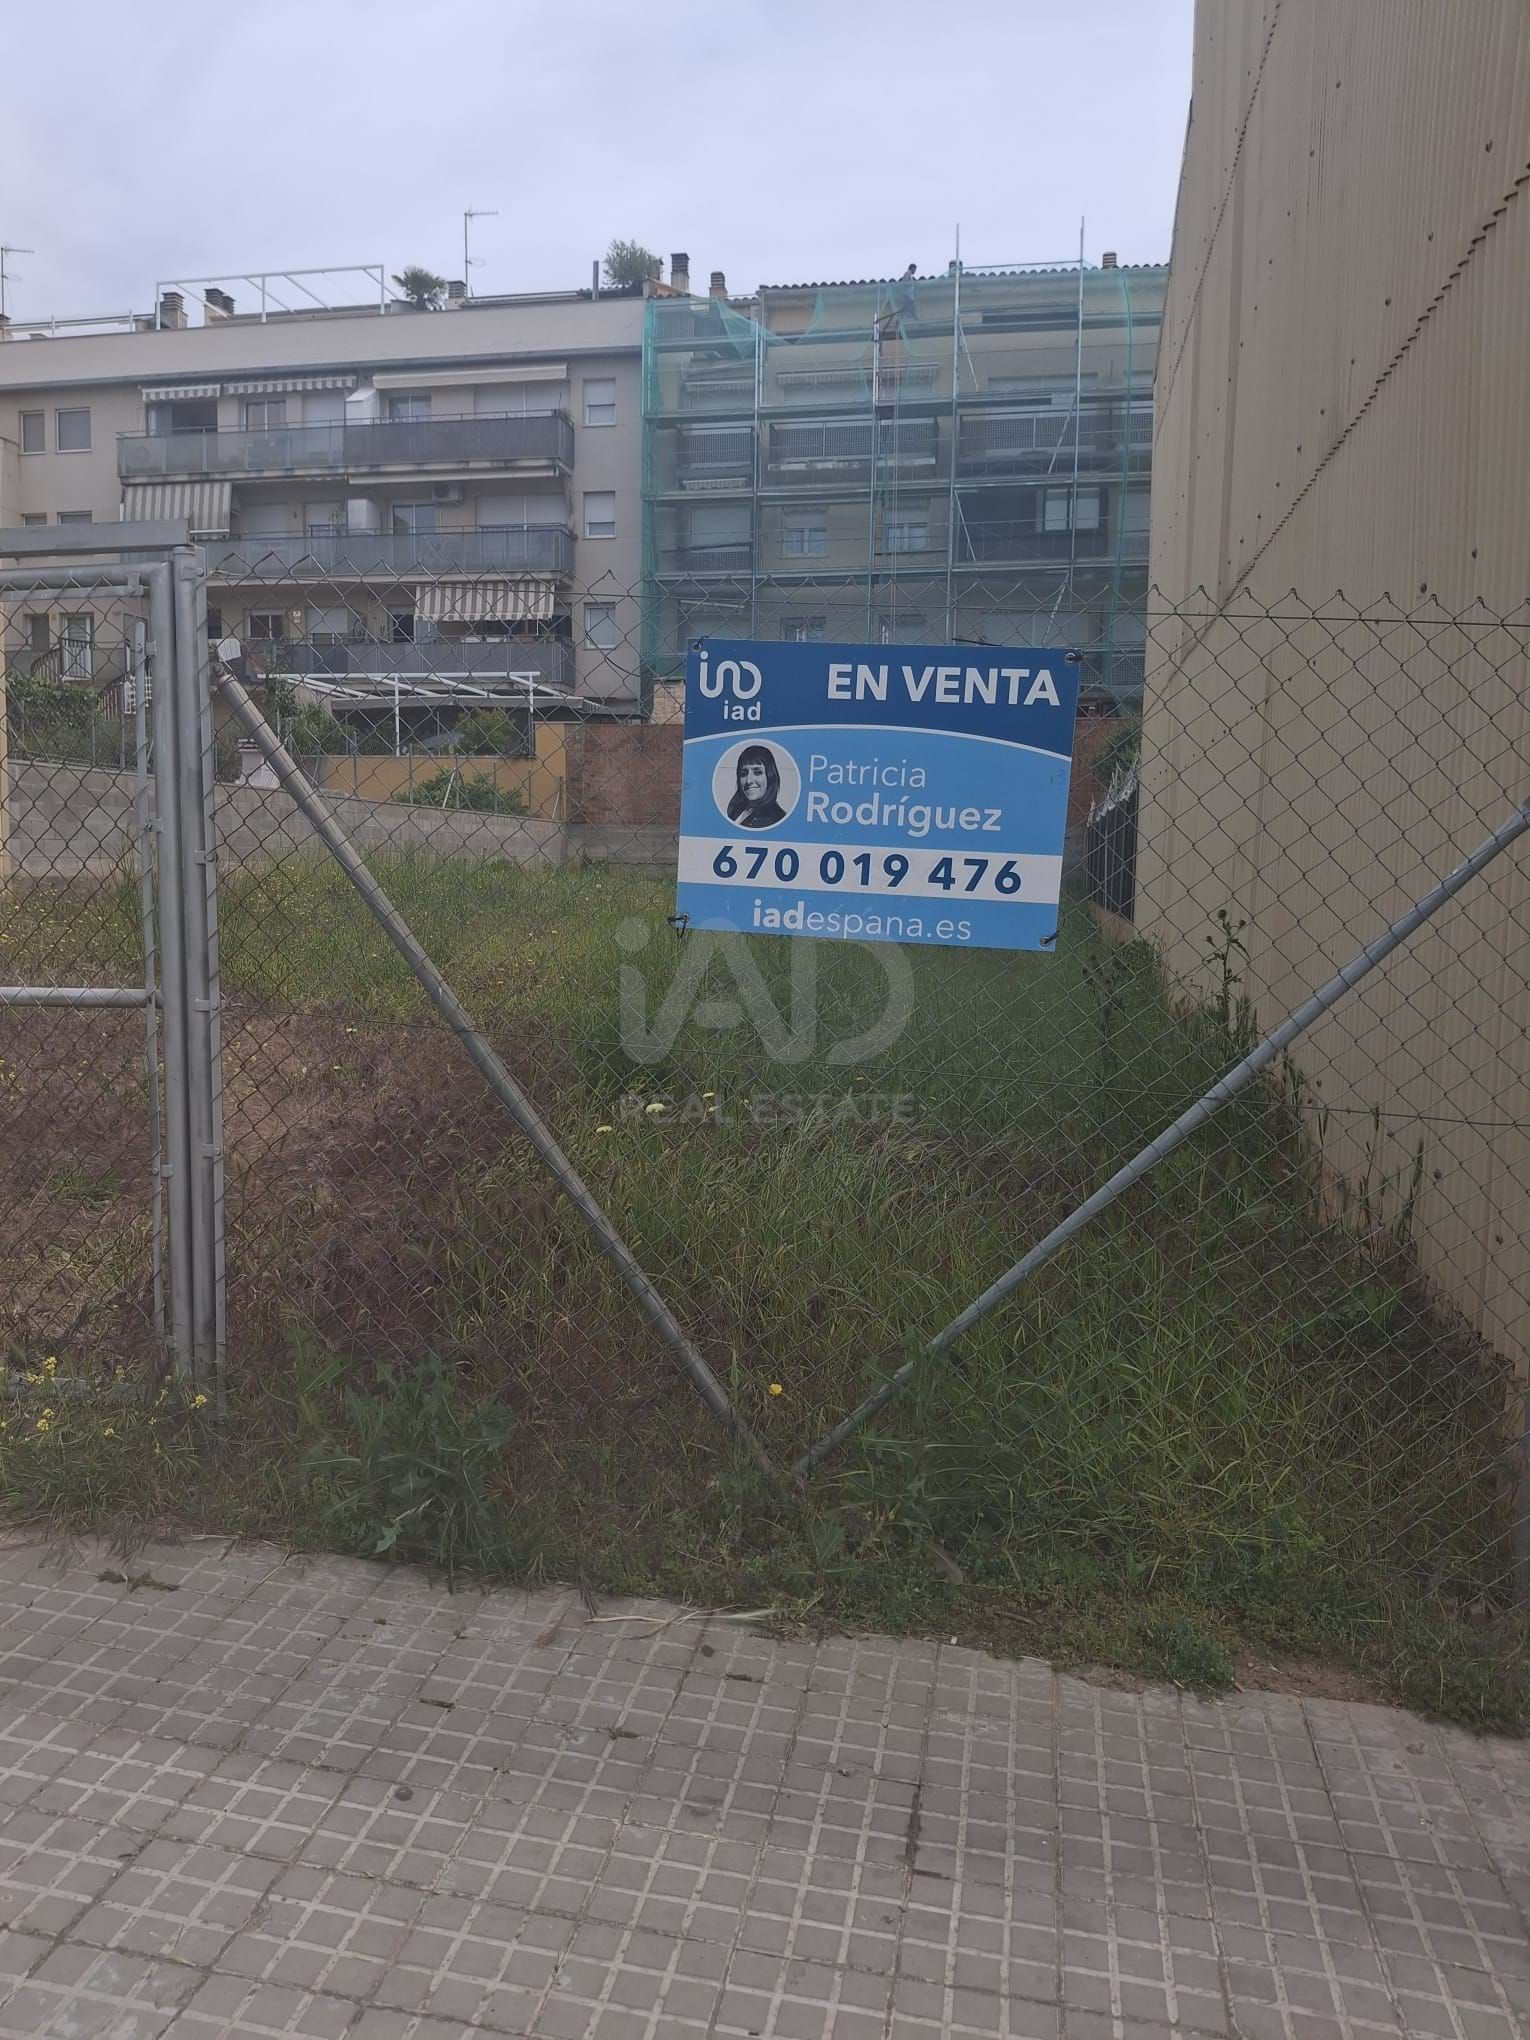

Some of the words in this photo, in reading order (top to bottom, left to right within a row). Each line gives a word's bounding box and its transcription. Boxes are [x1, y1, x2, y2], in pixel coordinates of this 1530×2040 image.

[827, 663, 889, 701] EN
[902, 665, 1061, 706] VENTA
[723, 701, 761, 721] iad
[808, 754, 927, 788] Patricia
[805, 790, 1002, 838] Rodríguez
[712, 845, 800, 882] 670
[819, 850, 909, 888] 019
[927, 857, 1022, 894] 476
[752, 899, 972, 940] iadespana.es
